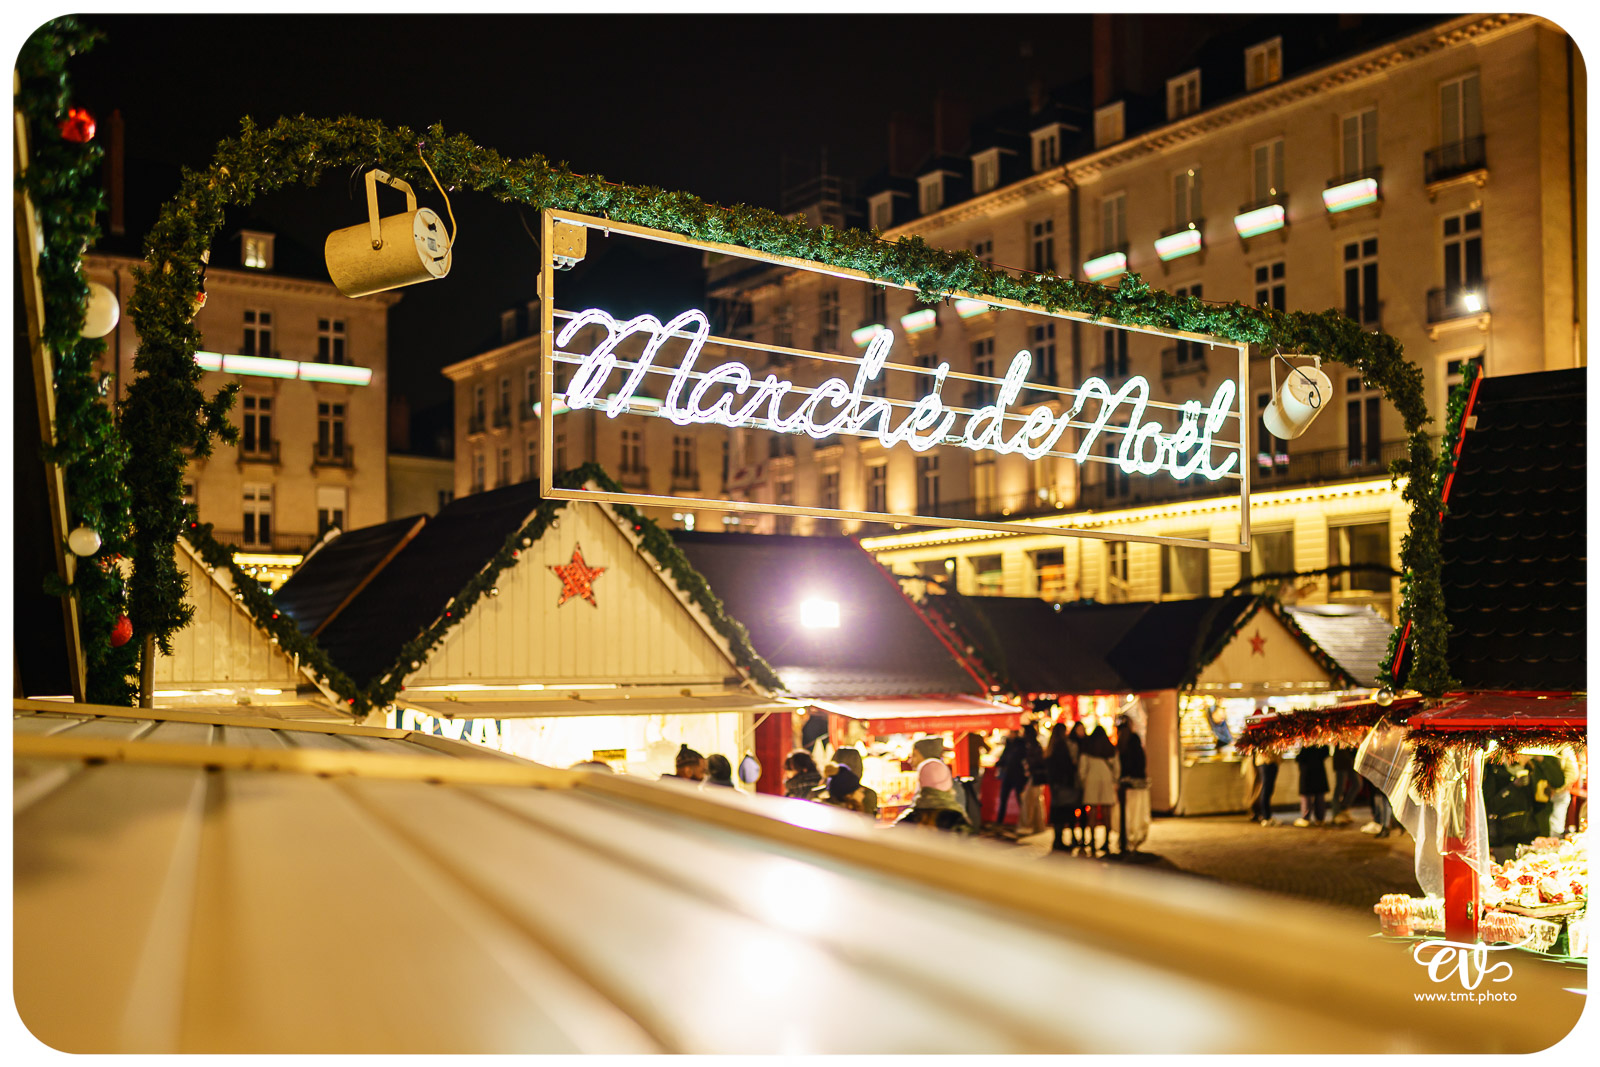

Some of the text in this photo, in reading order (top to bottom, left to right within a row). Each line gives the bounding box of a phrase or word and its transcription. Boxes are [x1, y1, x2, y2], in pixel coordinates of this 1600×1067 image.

[556, 308, 1238, 480] Marché de Noël
